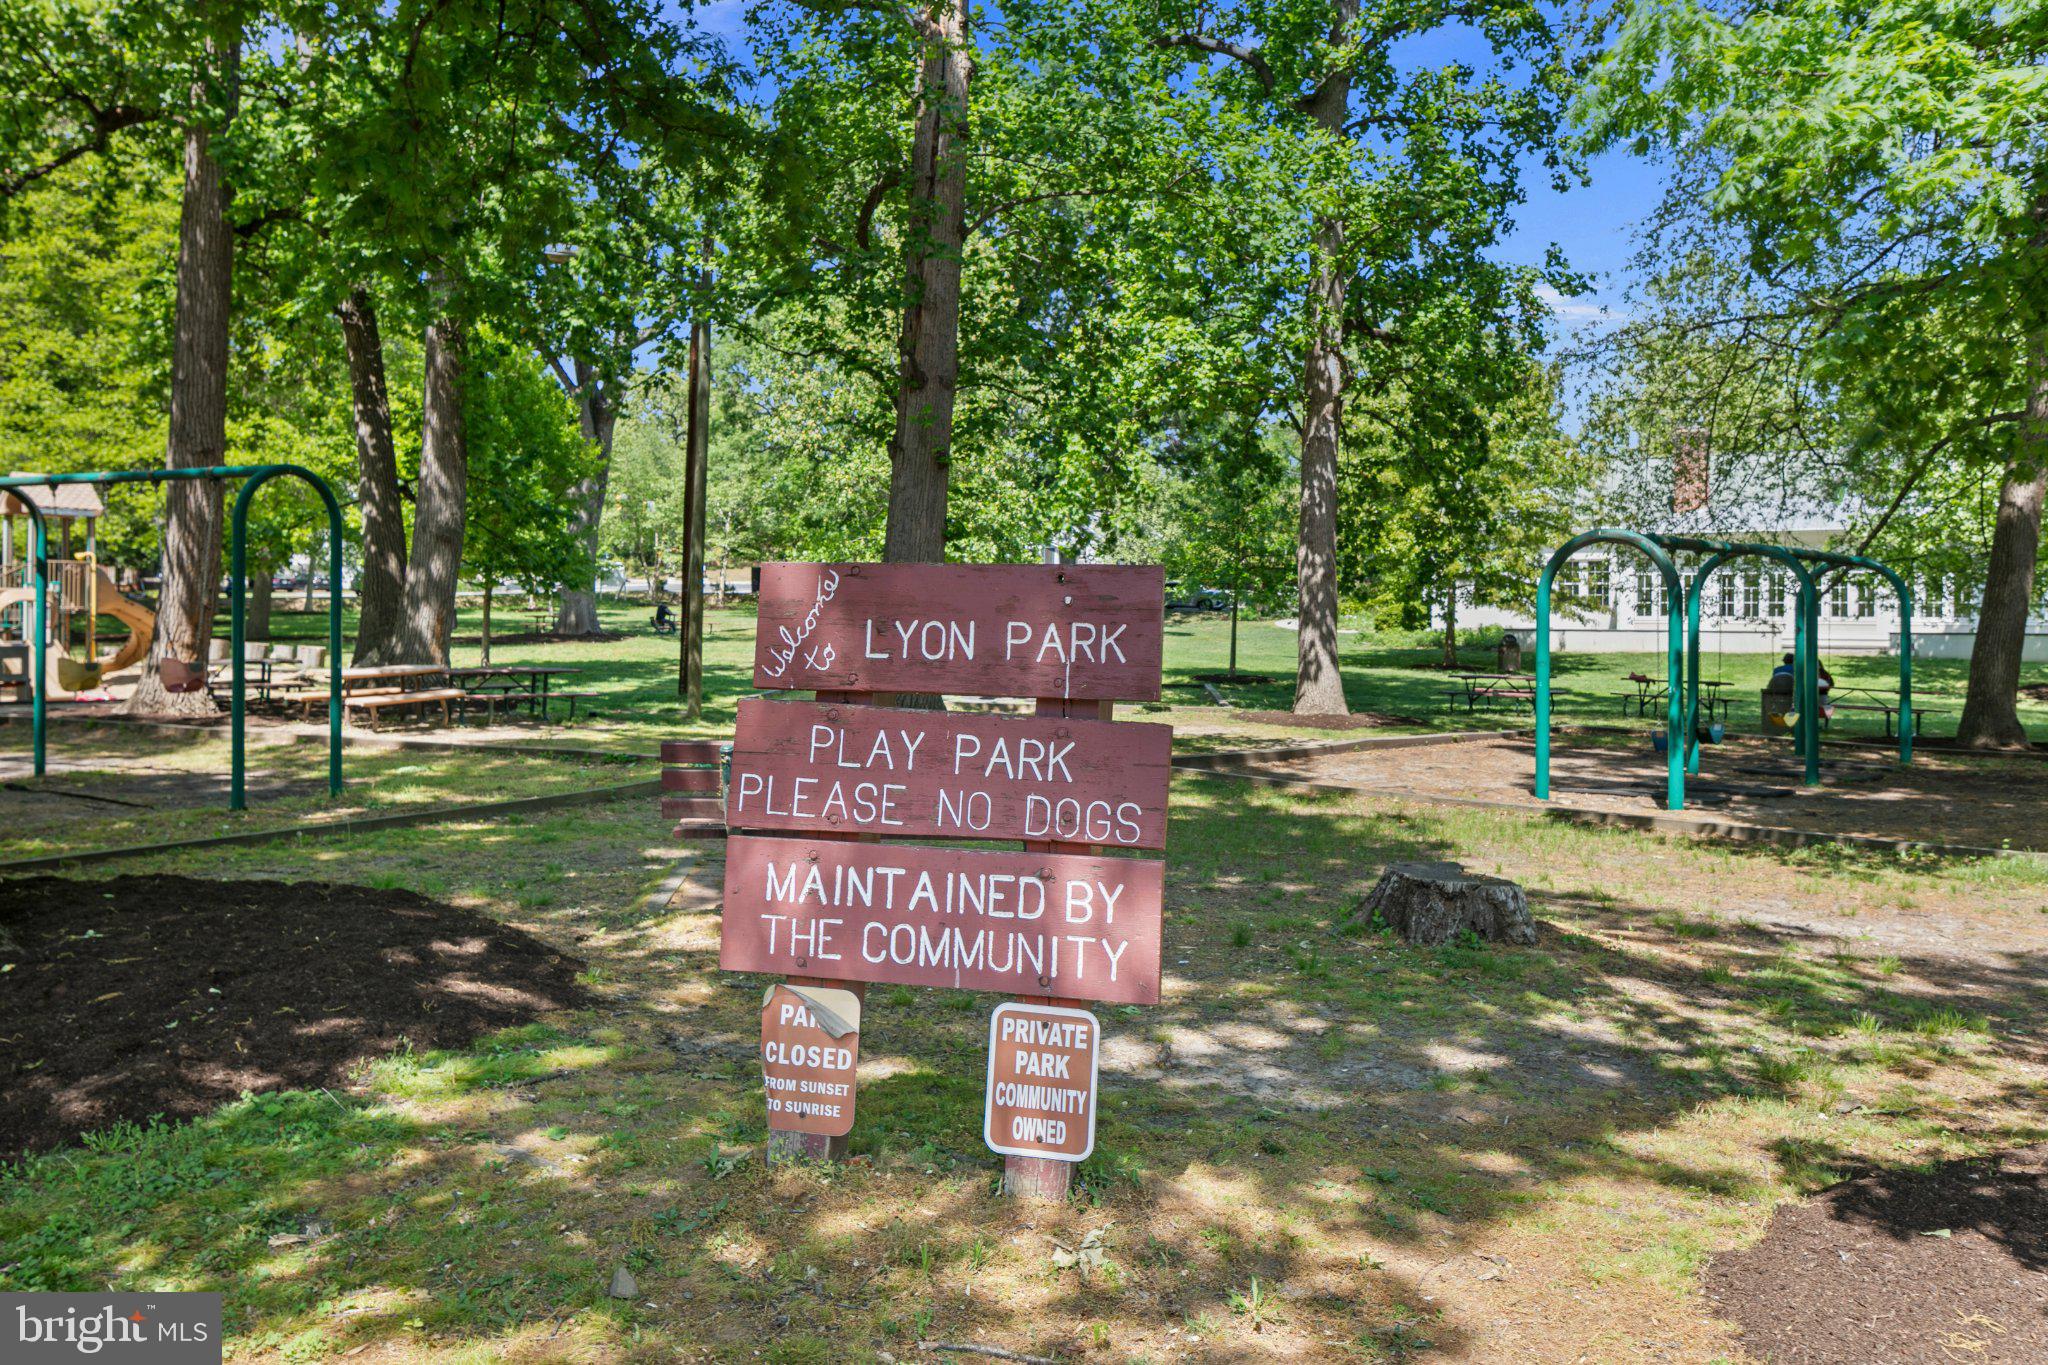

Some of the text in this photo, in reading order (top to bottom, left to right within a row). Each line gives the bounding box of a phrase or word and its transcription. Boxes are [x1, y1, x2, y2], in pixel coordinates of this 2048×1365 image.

[762, 569, 840, 678] Welcome
[865, 619, 1127, 664] LYON PARK
[809, 724, 1076, 784] PLAY PARK
[738, 773, 1143, 843] PLEASE NO DOGS
[765, 862, 1125, 924] MAINTAINED BY
[761, 914, 1129, 982] THE COMMUNITY
[1002, 1017, 1088, 1050] PRIVATE
[765, 1041, 852, 1070] CLOSED
[1015, 1050, 1071, 1080] PARK
[764, 1076, 850, 1097] FROM SUNSET
[995, 1081, 1088, 1115] COMMUNITY
[767, 1098, 841, 1118] TO SUNRISE
[1012, 1115, 1067, 1145] OWNED
